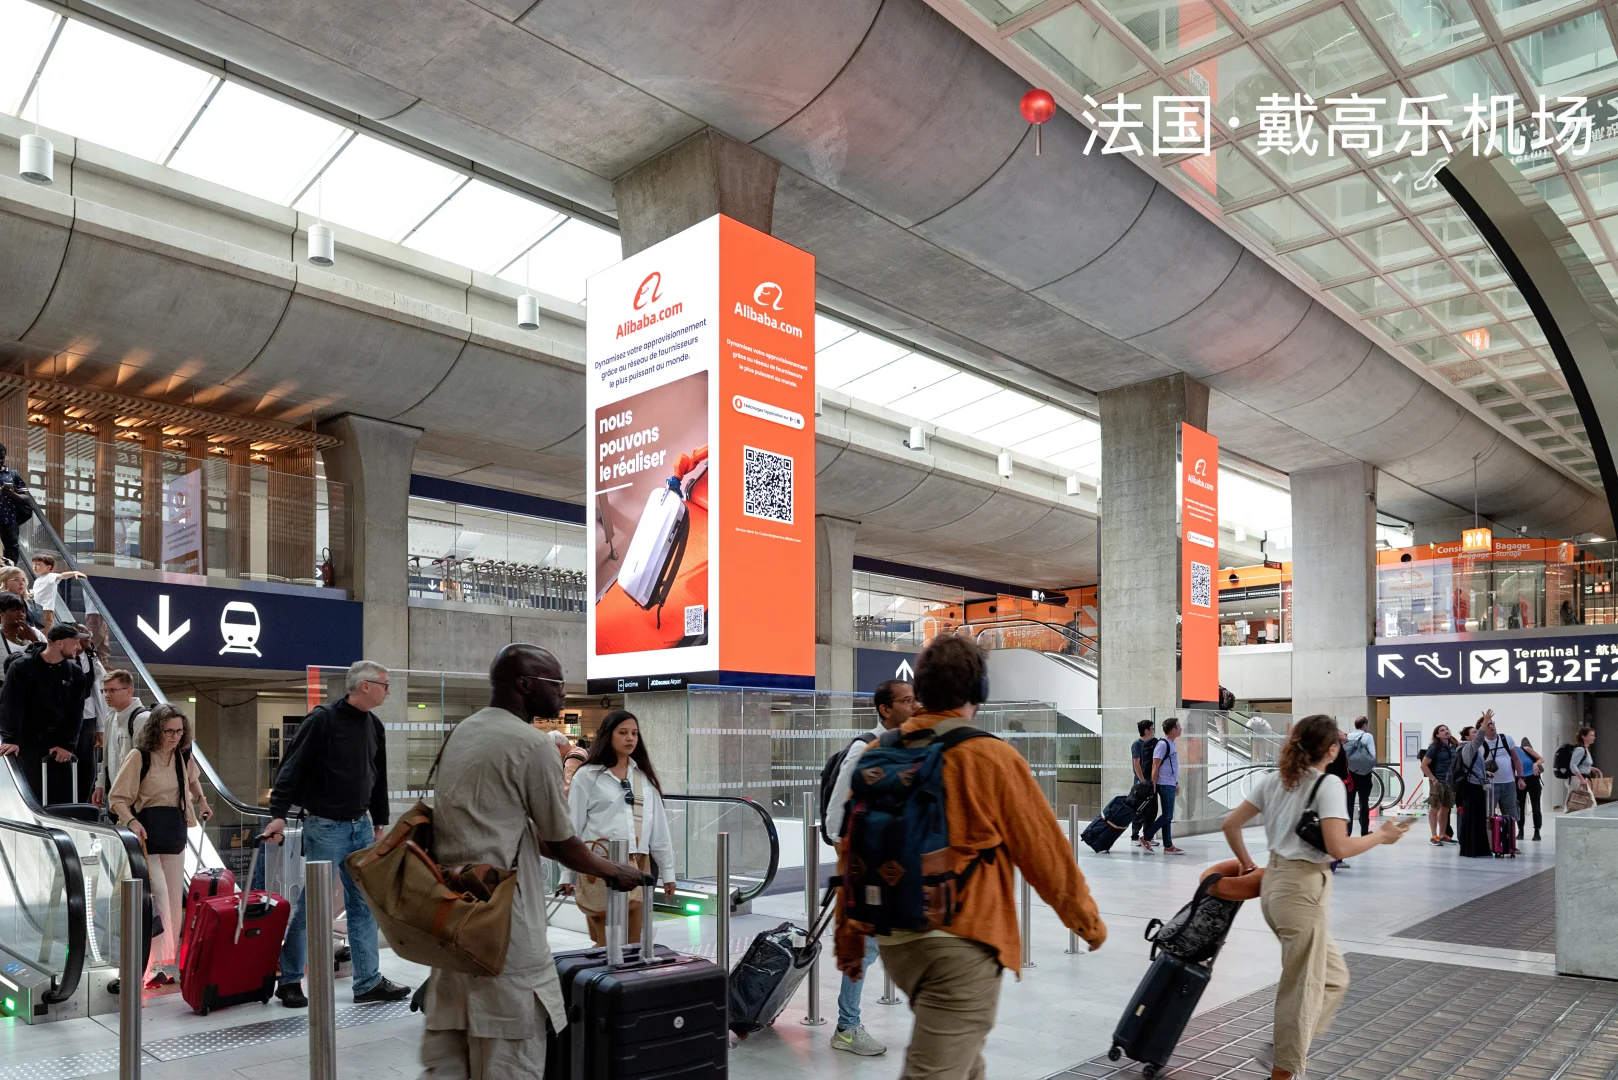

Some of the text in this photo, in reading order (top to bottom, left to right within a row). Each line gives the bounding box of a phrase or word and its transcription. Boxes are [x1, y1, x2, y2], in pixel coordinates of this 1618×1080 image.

[616, 302, 683, 340] Alibaba.com
[734, 301, 803, 338] Alibaba.com
[594, 318, 707, 370] Dynamisez votre approvisionnement
[601, 336, 699, 381] grâce au réseau de fournisseurs
[726, 338, 752, 352] Dynamisez
[753, 348, 765, 356] votre
[615, 376, 628, 388] plus
[628, 365, 655, 383] puissant
[655, 362, 665, 371] au
[665, 353, 691, 368] monde.
[600, 410, 633, 434] nous
[600, 426, 659, 462] pouvons
[600, 449, 667, 482] le réaliser
[1495, 542, 1531, 551] Bagages
[1513, 645, 1579, 658] Terminal
